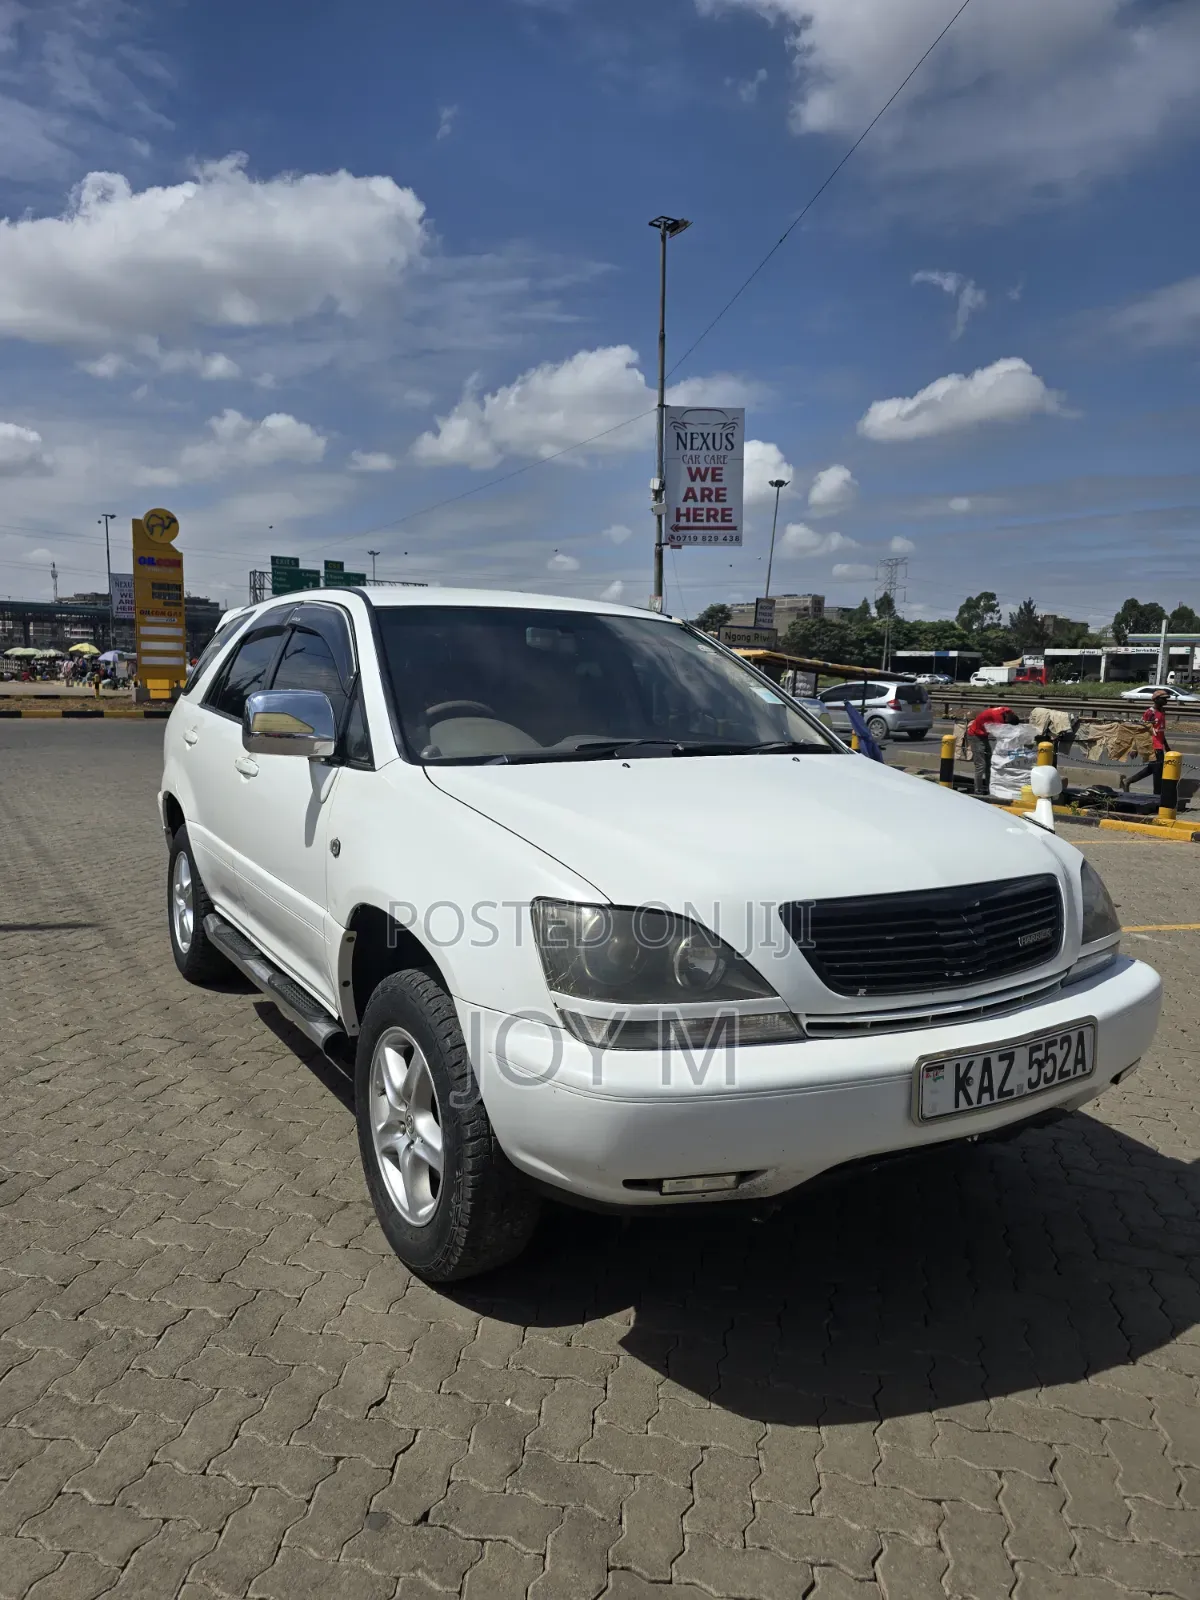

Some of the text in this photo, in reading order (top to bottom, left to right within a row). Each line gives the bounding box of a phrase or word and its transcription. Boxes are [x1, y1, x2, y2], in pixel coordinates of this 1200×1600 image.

[676, 432, 734, 451] NEXUS
[682, 455, 728, 465] CAR CARE
[687, 467, 723, 482] WE
[682, 487, 727, 502] ARE
[675, 507, 733, 523] HERE
[115, 580, 134, 588] NEXU
[725, 632, 751, 642] Ngong
[954, 1031, 1087, 1109] KAZ 552A
